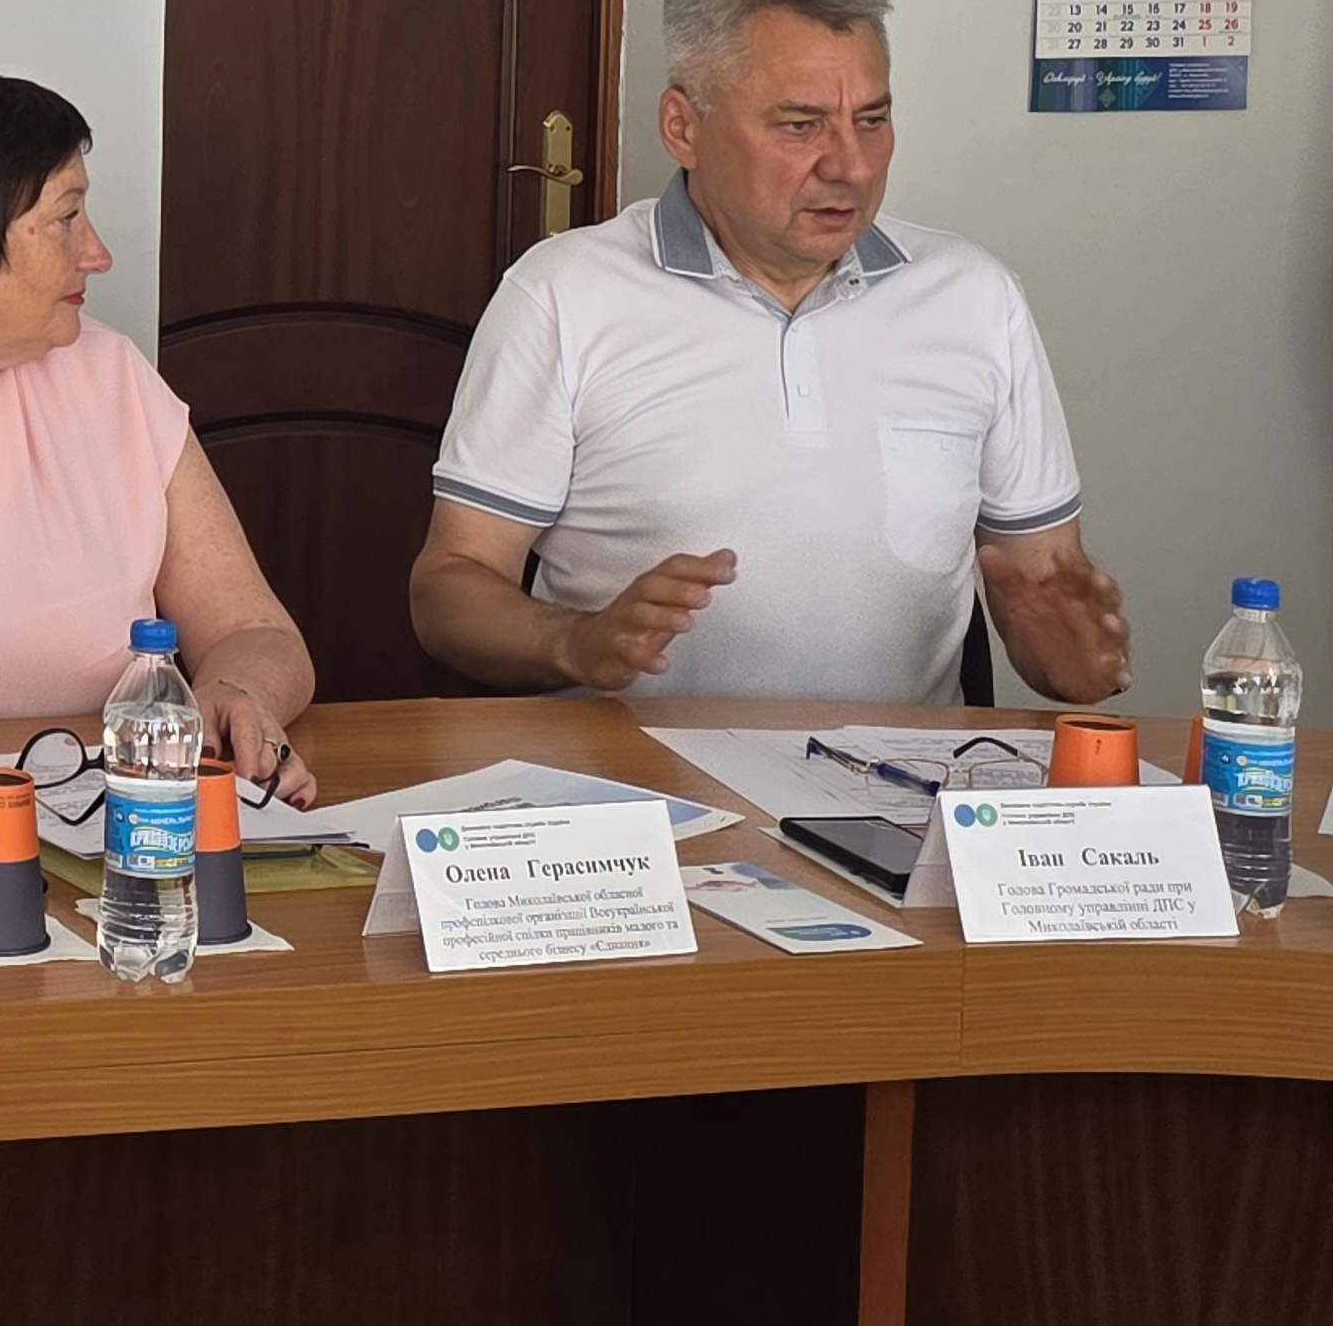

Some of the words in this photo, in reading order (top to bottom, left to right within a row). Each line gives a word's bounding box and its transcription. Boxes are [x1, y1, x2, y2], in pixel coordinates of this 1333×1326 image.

[1068, 23, 1082, 33] 20
[1095, 22, 1107, 32] 21
[1121, 22, 1133, 32] 22
[1147, 21, 1160, 31] 23
[1173, 21, 1185, 30] 24
[1199, 21, 1211, 29] 25
[1225, 20, 1238, 29] 26
[1018, 850, 1064, 867] Іван
[1082, 848, 1159, 866] Сакаль
[446, 866, 510, 884] Олена
[527, 855, 651, 880] Герасимчук
[997, 883, 1045, 896] Голова
[1049, 882, 1129, 898] Громадської
[1134, 882, 1164, 898] ради
[1169, 882, 1192, 896] при
[1001, 902, 1074, 917] Головному
[1079, 901, 1149, 916] управлінні
[1153, 900, 1184, 913] ДПС
[1188, 902, 1195, 914] у
[1029, 918, 1126, 934] Миколаївській
[1130, 920, 1178, 932] області
